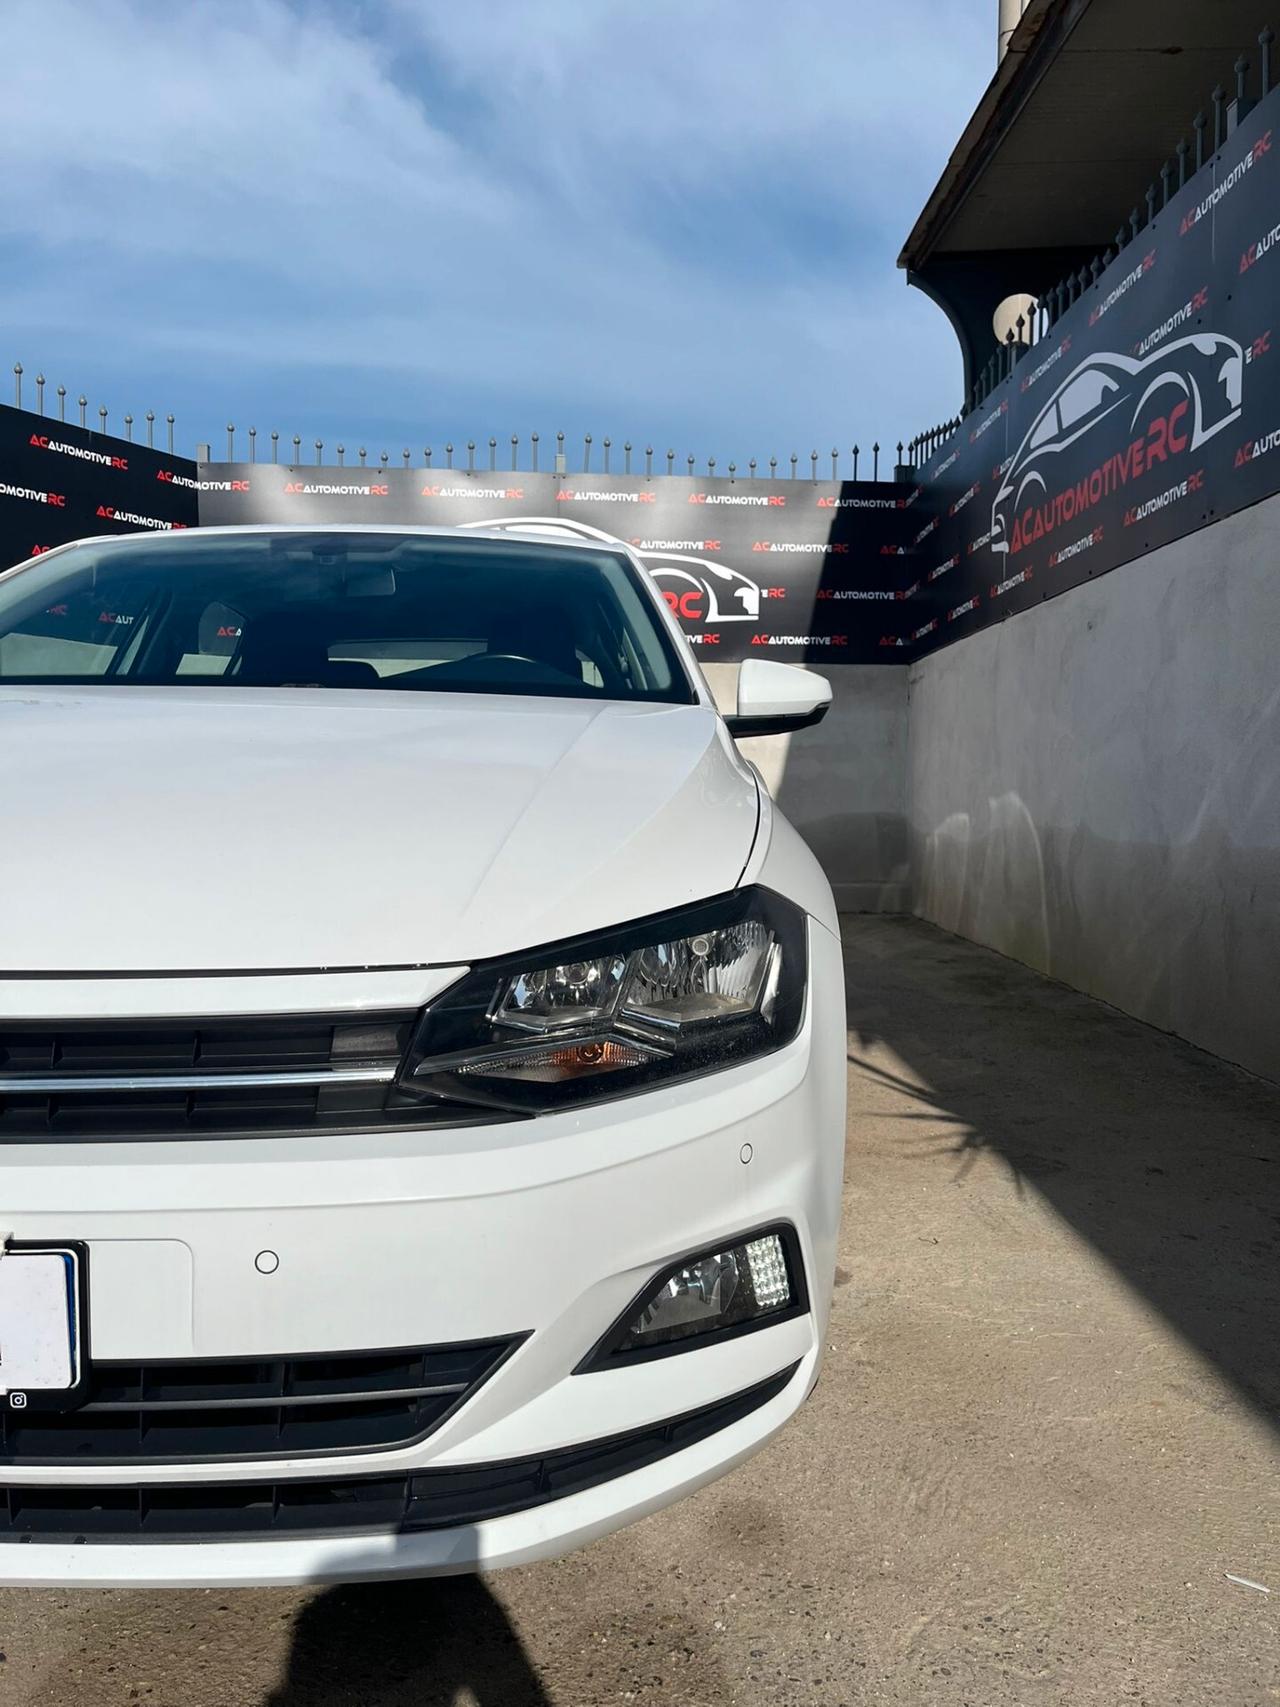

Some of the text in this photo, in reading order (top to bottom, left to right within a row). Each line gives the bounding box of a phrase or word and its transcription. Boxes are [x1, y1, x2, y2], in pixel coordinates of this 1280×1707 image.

[1180, 130, 1272, 236] ACAUTOMOTIVERC
[29, 433, 129, 471] ACAUTOMOTIVERC
[156, 469, 249, 494] ACAUTOMOTIVERC
[1011, 400, 1188, 553] ACAUTOMOTIVERC
[284, 483, 389, 496] ACAUTOMOTIVERC
[422, 486, 524, 499] ACAUTOMOTIVERC
[556, 490, 657, 503] ACAUTOMOTIVERC
[688, 492, 786, 506] ACAUTOMOTIVERC
[1123, 468, 1205, 527] ACAUTOMOTIVERC
[752, 541, 849, 553] ACAUTOMOTIVERC
[751, 634, 848, 646] ACAUTOMOTIVERC
